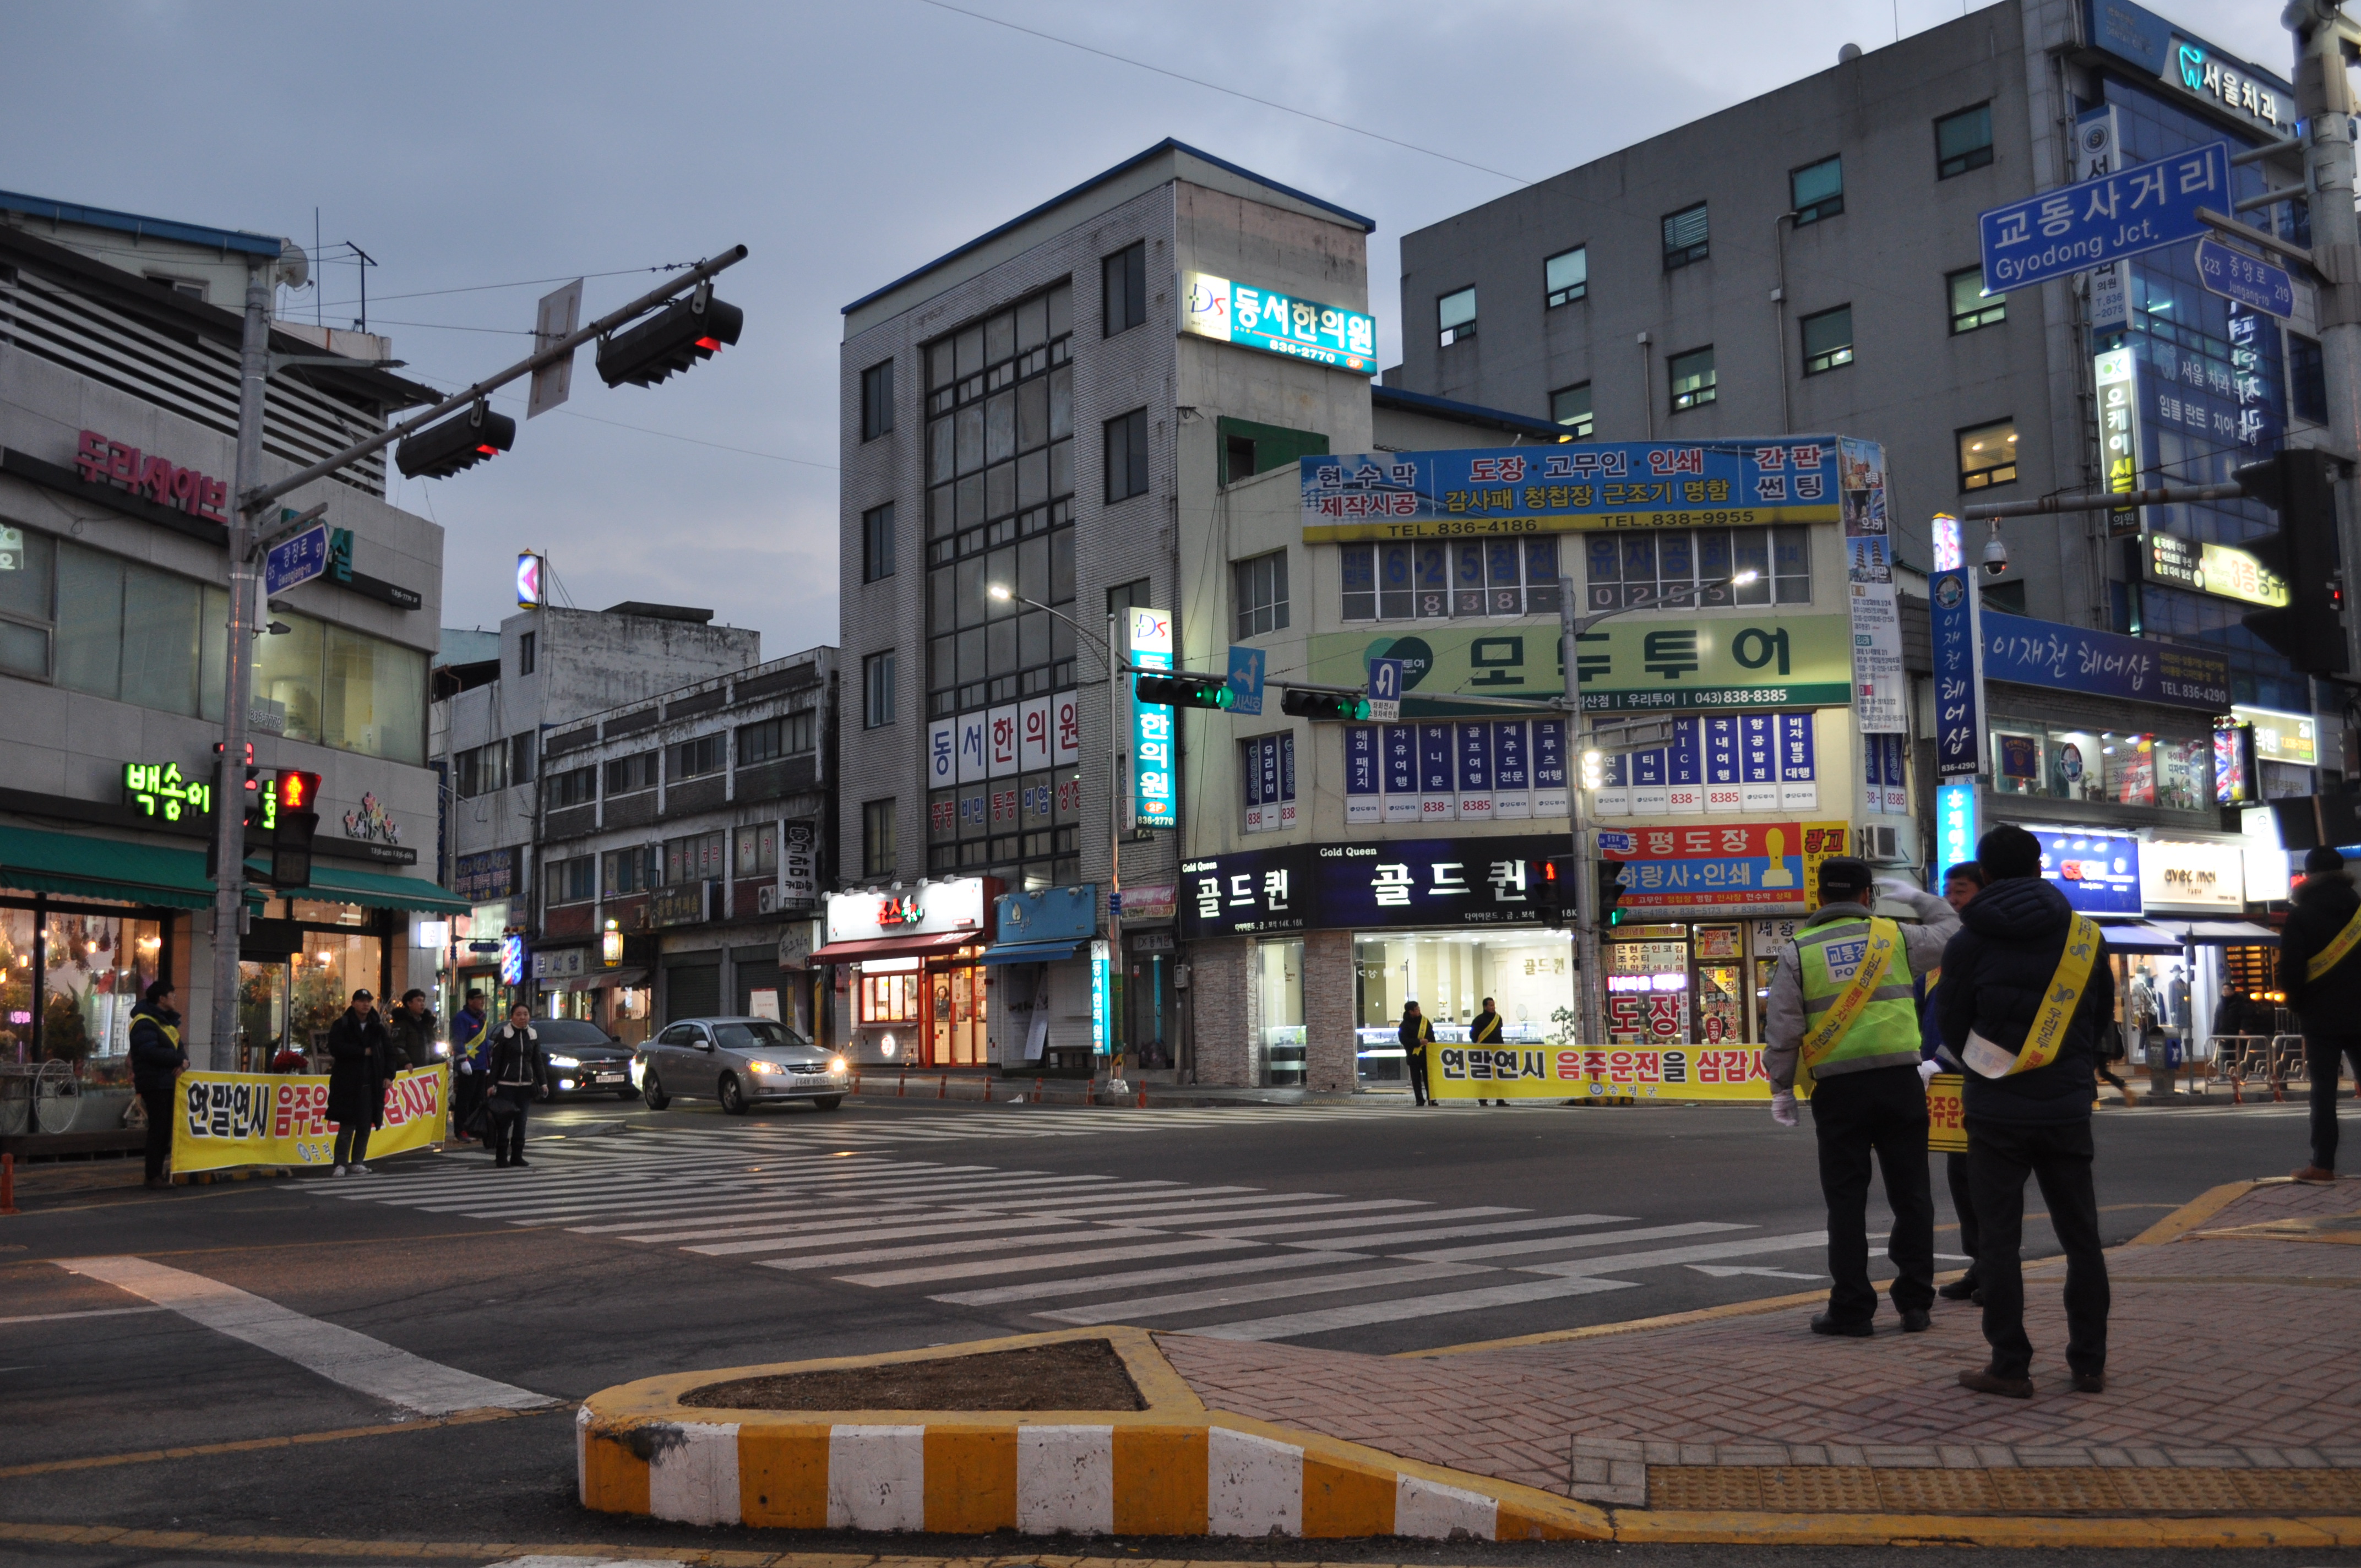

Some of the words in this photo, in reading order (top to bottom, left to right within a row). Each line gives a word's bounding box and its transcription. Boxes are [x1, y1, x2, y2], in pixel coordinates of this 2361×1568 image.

[2204, 62, 2277, 126] 서울치과
[1994, 151, 2216, 249] 교동사거리
[1995, 236, 2103, 280] Gyodong
[2112, 220, 2159, 248] Jct.
[2204, 256, 2221, 276] 223
[2229, 255, 2266, 285] 중앙로
[2097, 277, 2117, 291] 의원
[2228, 280, 2270, 307] Jungang-ro
[2275, 284, 2289, 302] 219
[2095, 304, 2124, 318] -2075
[2096, 292, 2123, 307] T.836
[1234, 286, 1373, 356] 동서한의원
[1269, 339, 1336, 364] 836-2770
[1349, 358, 1360, 368] 2F
[2182, 361, 2204, 386] 서울
[2208, 369, 2230, 396] 치과
[2106, 388, 2129, 456] 오케이
[1468, 454, 1526, 483] 도장
[1543, 450, 1628, 479] 고무인
[1647, 447, 1704, 476] 인쇄
[1752, 444, 1821, 471] 간판
[73, 429, 229, 524] 두리세이브
[1316, 461, 1416, 489] 현수막
[1753, 474, 1824, 502] 썬팅
[1320, 490, 1418, 518] 제작시공
[1444, 487, 1513, 513] 감사패
[1524, 484, 1594, 510] 청첩장
[1602, 481, 1672, 505] 근조기
[1683, 478, 1731, 502] 명함
[1388, 519, 1537, 538] TEL.836-4186
[1600, 510, 1755, 528] TEL.838-9955
[2113, 512, 2134, 526] 의원
[283, 538, 307, 568] 광장로
[315, 542, 324, 558] 91
[1490, 542, 1554, 581] 참전
[268, 564, 276, 581] 95
[2232, 559, 2255, 593] 3층
[1943, 613, 1961, 671] 이재천
[1470, 627, 1791, 686] 모두투어
[1992, 633, 2069, 678] 이재천
[2077, 640, 2151, 691] 헤어샵
[1372, 701, 1395, 710] 좌회전시
[1627, 692, 1675, 706] 우리투어
[1694, 688, 1787, 704] 043)838-8385
[1940, 677, 1971, 755] 헤어샵
[933, 701, 1078, 776] 동서한의원
[1355, 729, 1368, 752] 해외
[1503, 725, 1518, 766] 제주도
[1542, 725, 1557, 765] 크루즈
[1677, 721, 1690, 780] MICE
[1714, 721, 1730, 781] 국내여행
[1750, 718, 1766, 779] 항공발권
[1264, 744, 1274, 794] 우리투어
[1393, 729, 1408, 787] 자유여행
[1429, 727, 1444, 787] 허니문
[1467, 726, 1482, 785] 골프여행
[1603, 755, 1617, 783] 연수
[1642, 754, 1656, 781] 티브
[1941, 761, 1976, 772] 836-4290
[1355, 756, 1369, 788] 패키지
[1500, 769, 1525, 782] 전문
[1538, 769, 1563, 781] 여행
[1785, 766, 1811, 779] 대행
[126, 761, 210, 822] 백송이
[1671, 793, 1701, 804] 838-
[1710, 792, 1740, 803] 8385
[1887, 792, 1905, 805] 8385
[931, 801, 954, 832] 중풍
[961, 796, 984, 826] 비만
[992, 790, 1016, 822] 통증
[1024, 785, 1049, 816] 비염
[1149, 803, 1162, 812] 2F
[1248, 812, 1260, 825] 838
[1423, 801, 1453, 812] 838-
[1462, 800, 1491, 811] 8385
[1137, 815, 1174, 826] 836-2770
[788, 827, 810, 877] 동그라미
[1320, 847, 1343, 857] Gold
[1346, 846, 1377, 857] Queen
[1804, 828, 1845, 853] 광고
[1182, 863, 1196, 873] Gold
[1198, 861, 1217, 872] Queen
[2164, 868, 2193, 883] avec
[2196, 869, 2217, 883] moi
[785, 880, 813, 892] 커피숍
[1196, 868, 1288, 918] 골드퀸
[1370, 859, 1527, 906] 골드퀸
[1618, 897, 1633, 905] 도장
[1638, 896, 1662, 905] 고무인
[1667, 895, 1691, 903] 청첩장
[1695, 894, 1712, 903] 명함
[1716, 894, 1742, 902] 인사장
[1745, 892, 1771, 901] 현수막
[1776, 891, 1792, 900] 상패
[1679, 906, 1721, 916] 838-5173
[1465, 912, 1499, 922] 다이아몬드
[1506, 911, 1514, 920] 금
[1521, 910, 1535, 919] 보석
[1607, 945, 1616, 973] 기념품
[1617, 945, 1626, 972] 근조기
[1629, 945, 1640, 972] 현수막
[1640, 945, 1650, 972] 스티커
[1651, 945, 1661, 972] 인쇄
[1674, 944, 1685, 972] 감사패
[1766, 946, 1783, 954] 836
[1828, 942, 1867, 963] 교통경
[1524, 957, 1565, 976] 골드퀸
[1092, 960, 1104, 1040] 동서한의원
[1609, 993, 1681, 1037] 도장
[2035, 1007, 2062, 1049] 우리모두
[1709, 1021, 1719, 1040] 도장
[1439, 1047, 1545, 1082] 연말연시
[1555, 1049, 1687, 1085] 음주운전을
[1607, 1084, 1658, 1097] 증평군
[187, 1080, 270, 1139] 연말연시
[1925, 1095, 1965, 1129] 주운
